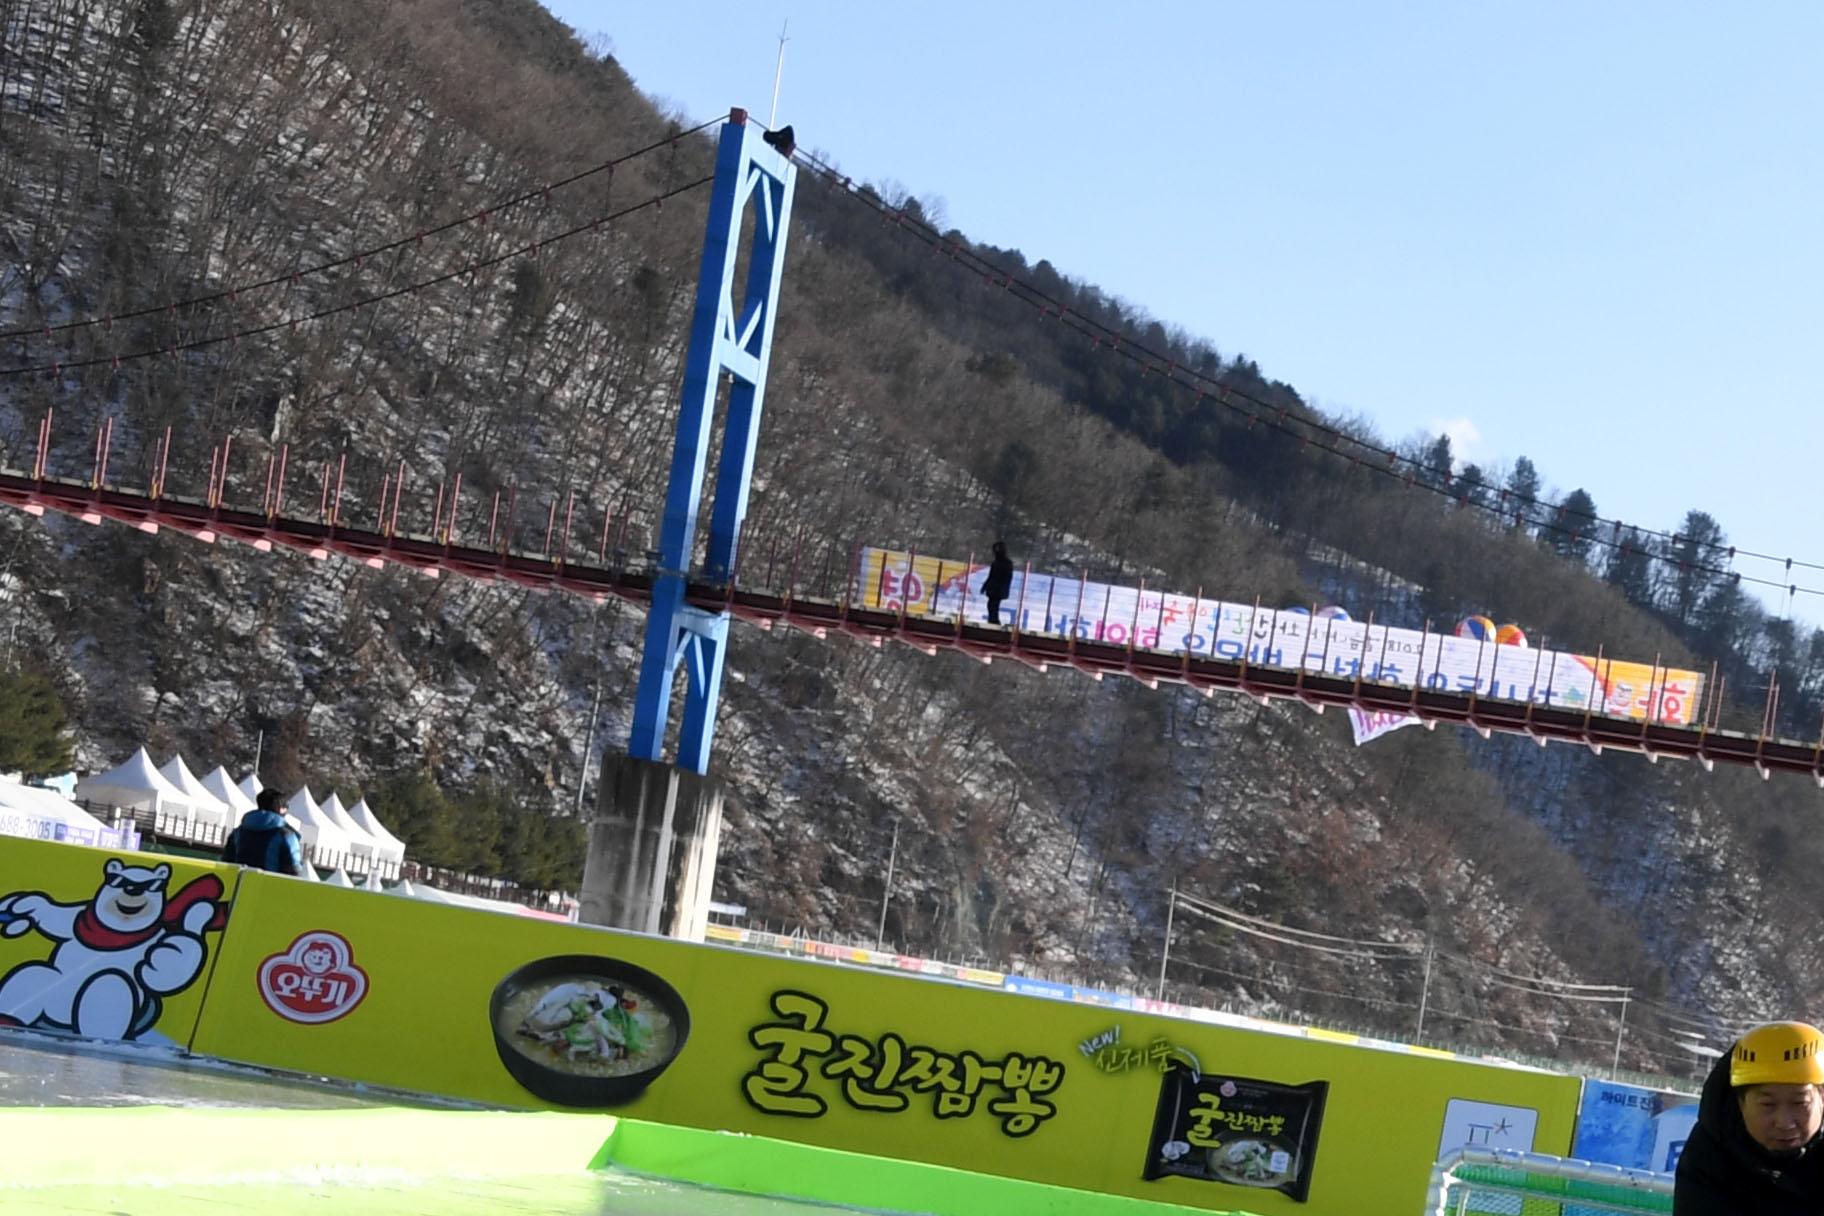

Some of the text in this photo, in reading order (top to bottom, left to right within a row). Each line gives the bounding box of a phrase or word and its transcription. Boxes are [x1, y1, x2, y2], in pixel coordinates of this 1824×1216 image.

[274, 971, 348, 1006] 오뚜기
[1079, 1024, 1121, 1057] New!
[1096, 1037, 1177, 1073] 신제품
[742, 989, 1065, 1138] 굴진짬뽕
